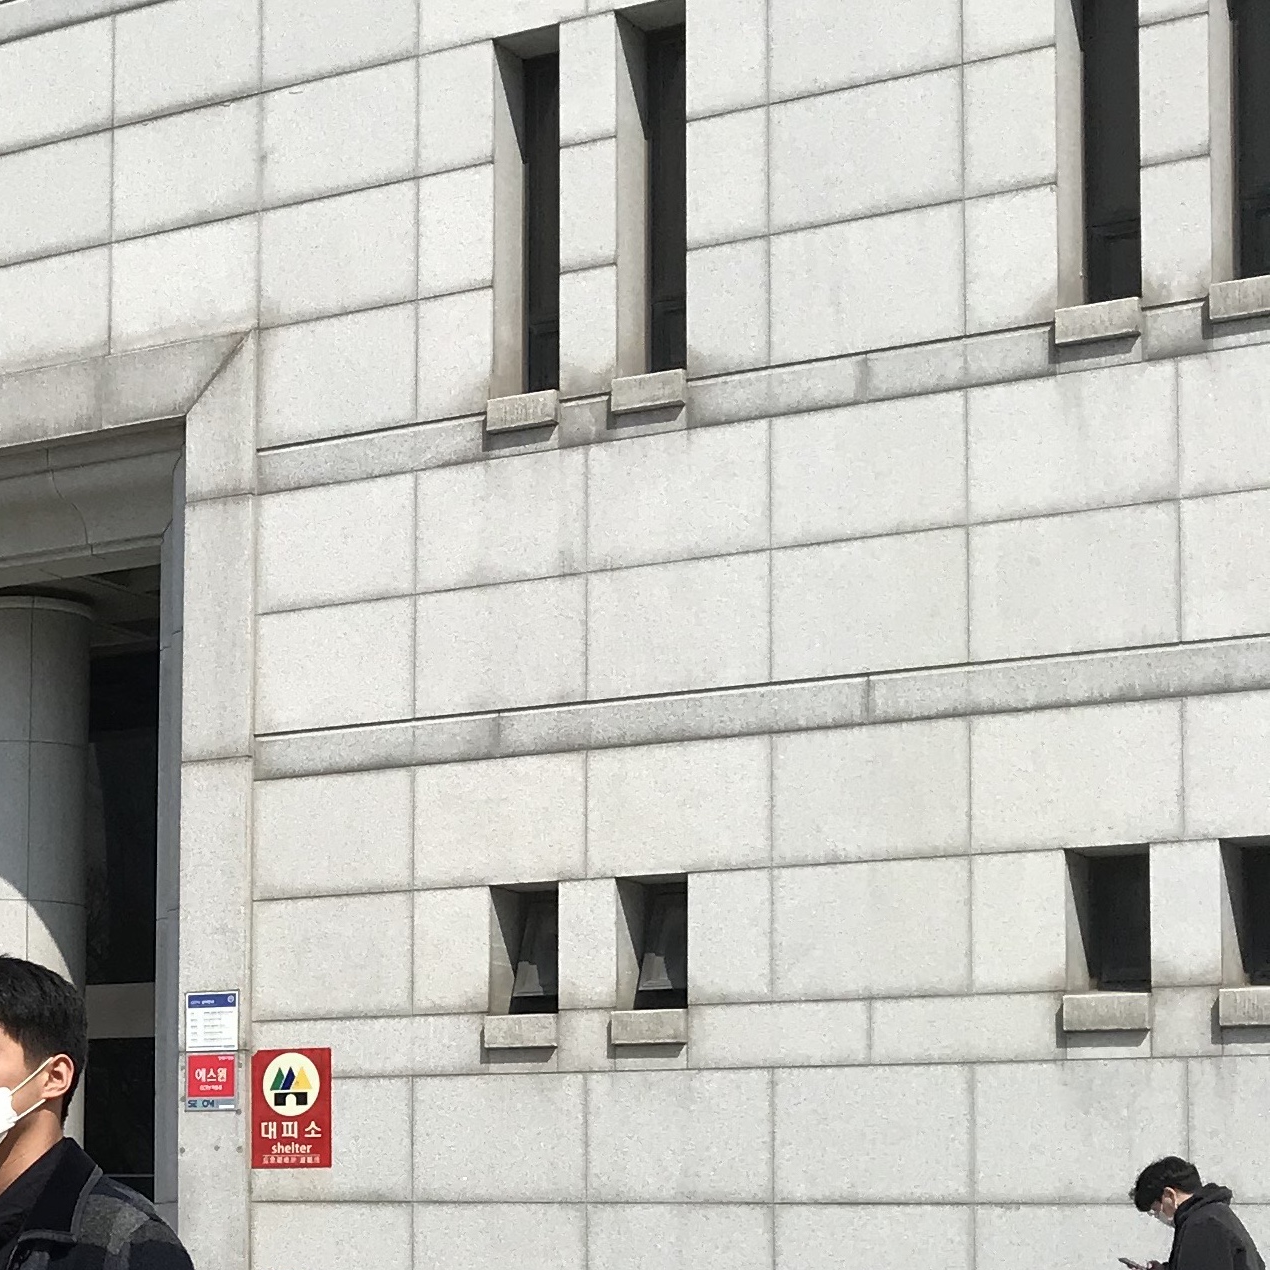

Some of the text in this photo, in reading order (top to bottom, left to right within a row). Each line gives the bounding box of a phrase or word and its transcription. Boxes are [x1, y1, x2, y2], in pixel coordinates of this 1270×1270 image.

[195, 1068, 227, 1082] 에스원
[188, 1100, 215, 1108] SEOM
[261, 1121, 322, 1139] 대피소
[271, 1142, 312, 1154] shelter
